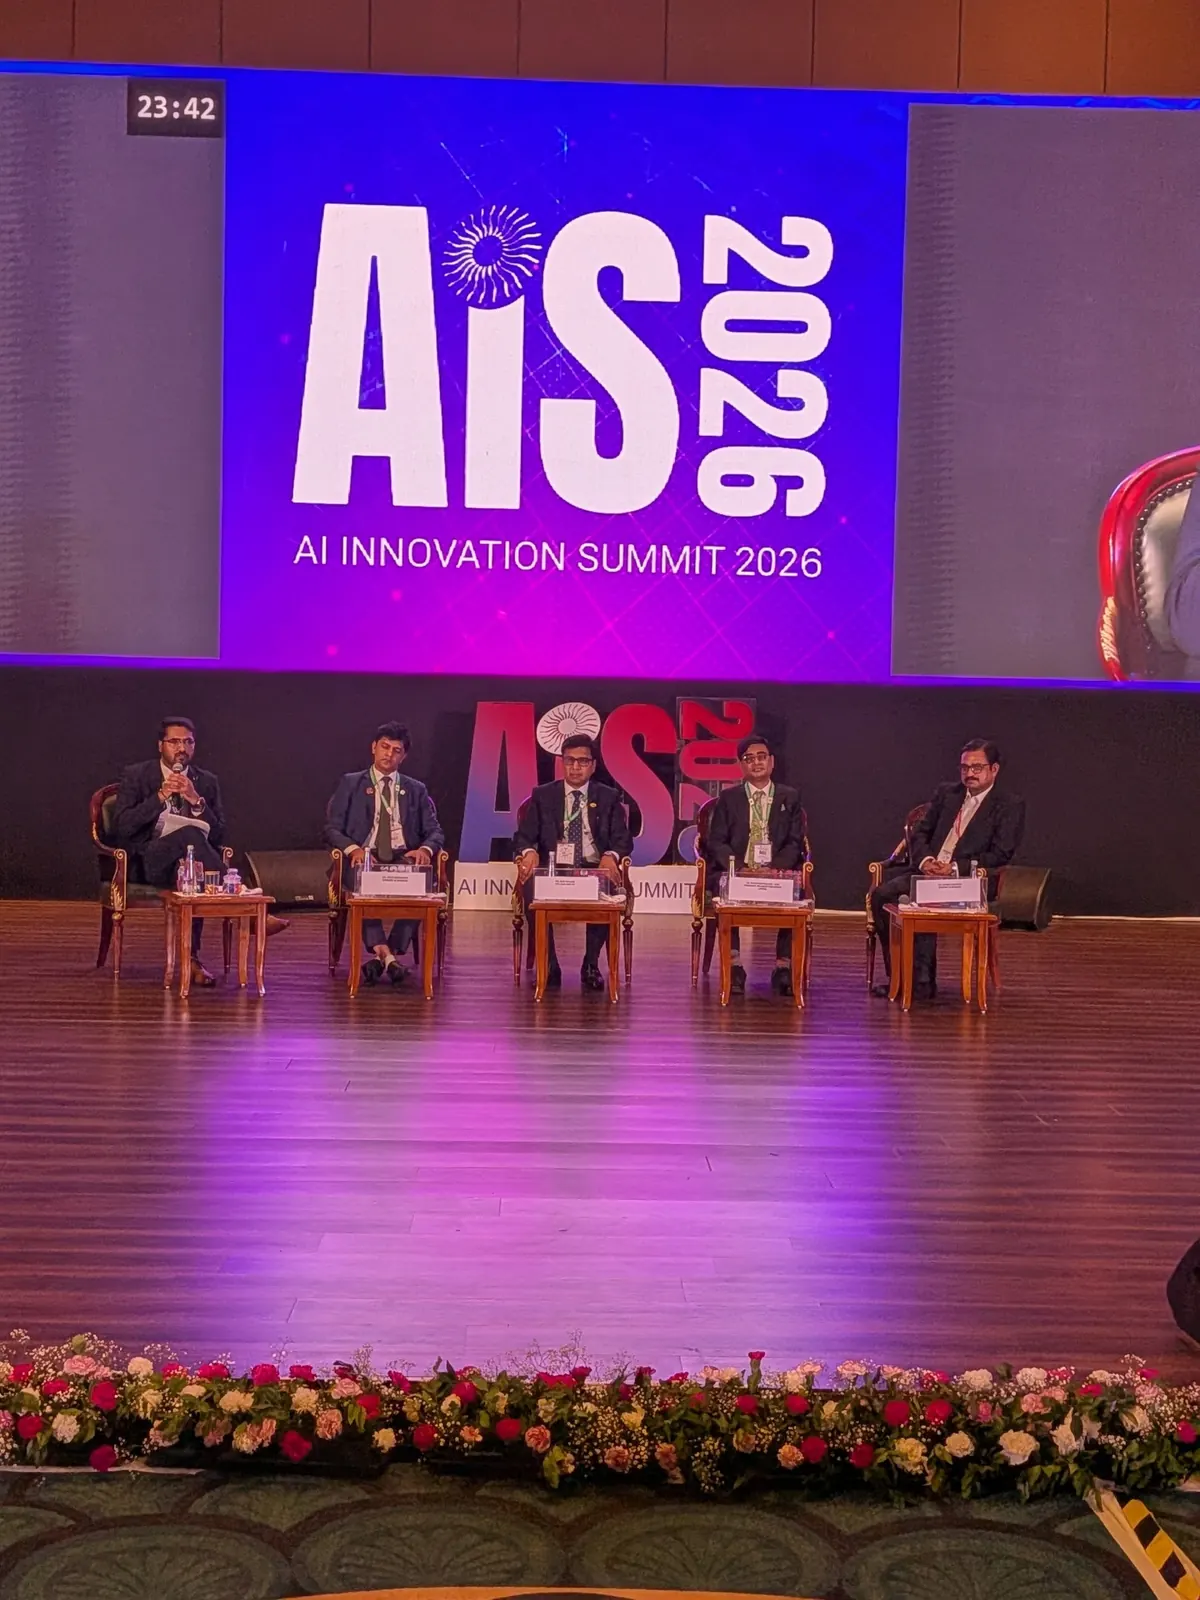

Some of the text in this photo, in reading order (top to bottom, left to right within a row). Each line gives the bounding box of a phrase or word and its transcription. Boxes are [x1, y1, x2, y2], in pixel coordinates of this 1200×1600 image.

[137, 94, 217, 120] 23:42
[697, 214, 834, 518] 2026
[293, 535, 822, 578] AI INNOVATION SUMMIT 2026
[457, 878, 477, 895] AI
[633, 881, 697, 899] UMMIT
